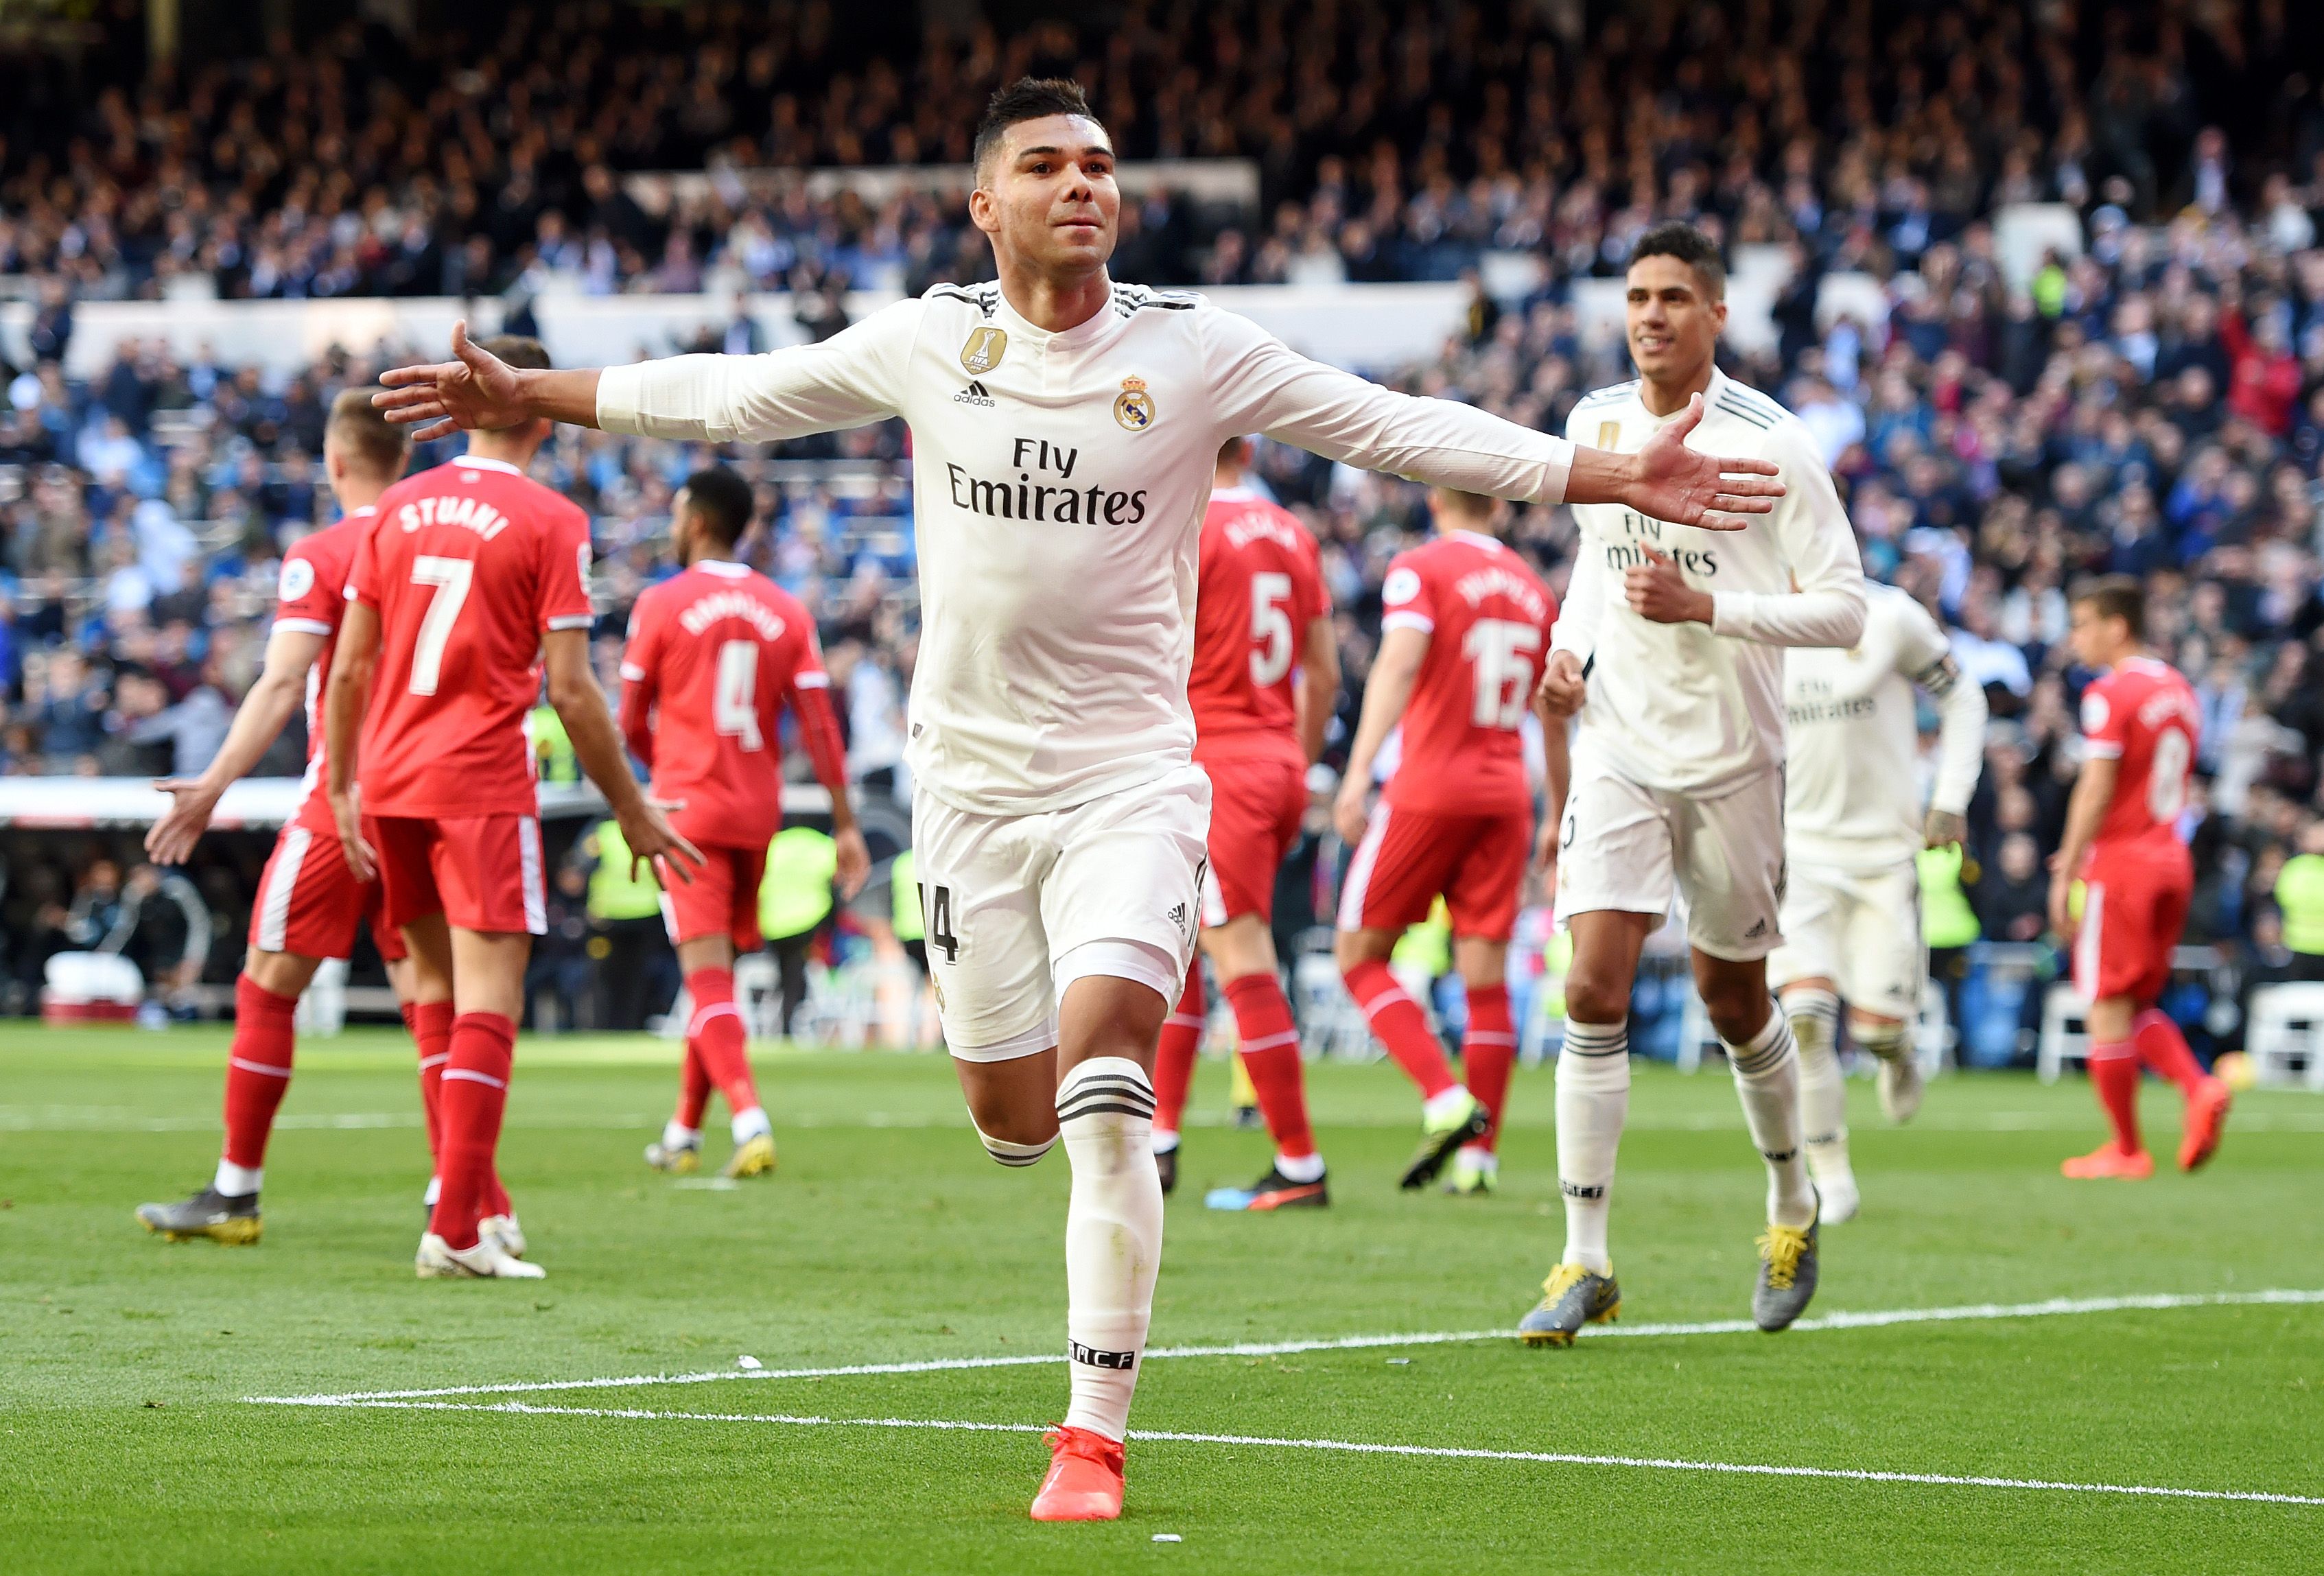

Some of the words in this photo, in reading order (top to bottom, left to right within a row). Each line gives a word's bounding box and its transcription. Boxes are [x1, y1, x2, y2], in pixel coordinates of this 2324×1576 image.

[970, 355, 988, 365] FIFA
[954, 395, 995, 408] adidas
[1013, 438, 1077, 478] Fly
[399, 496, 509, 541] STUANI
[946, 462, 1147, 526] Emirates
[410, 554, 475, 696] 7
[1249, 571, 1293, 687] 5
[712, 639, 764, 752] 4
[1462, 619, 1541, 731] 15
